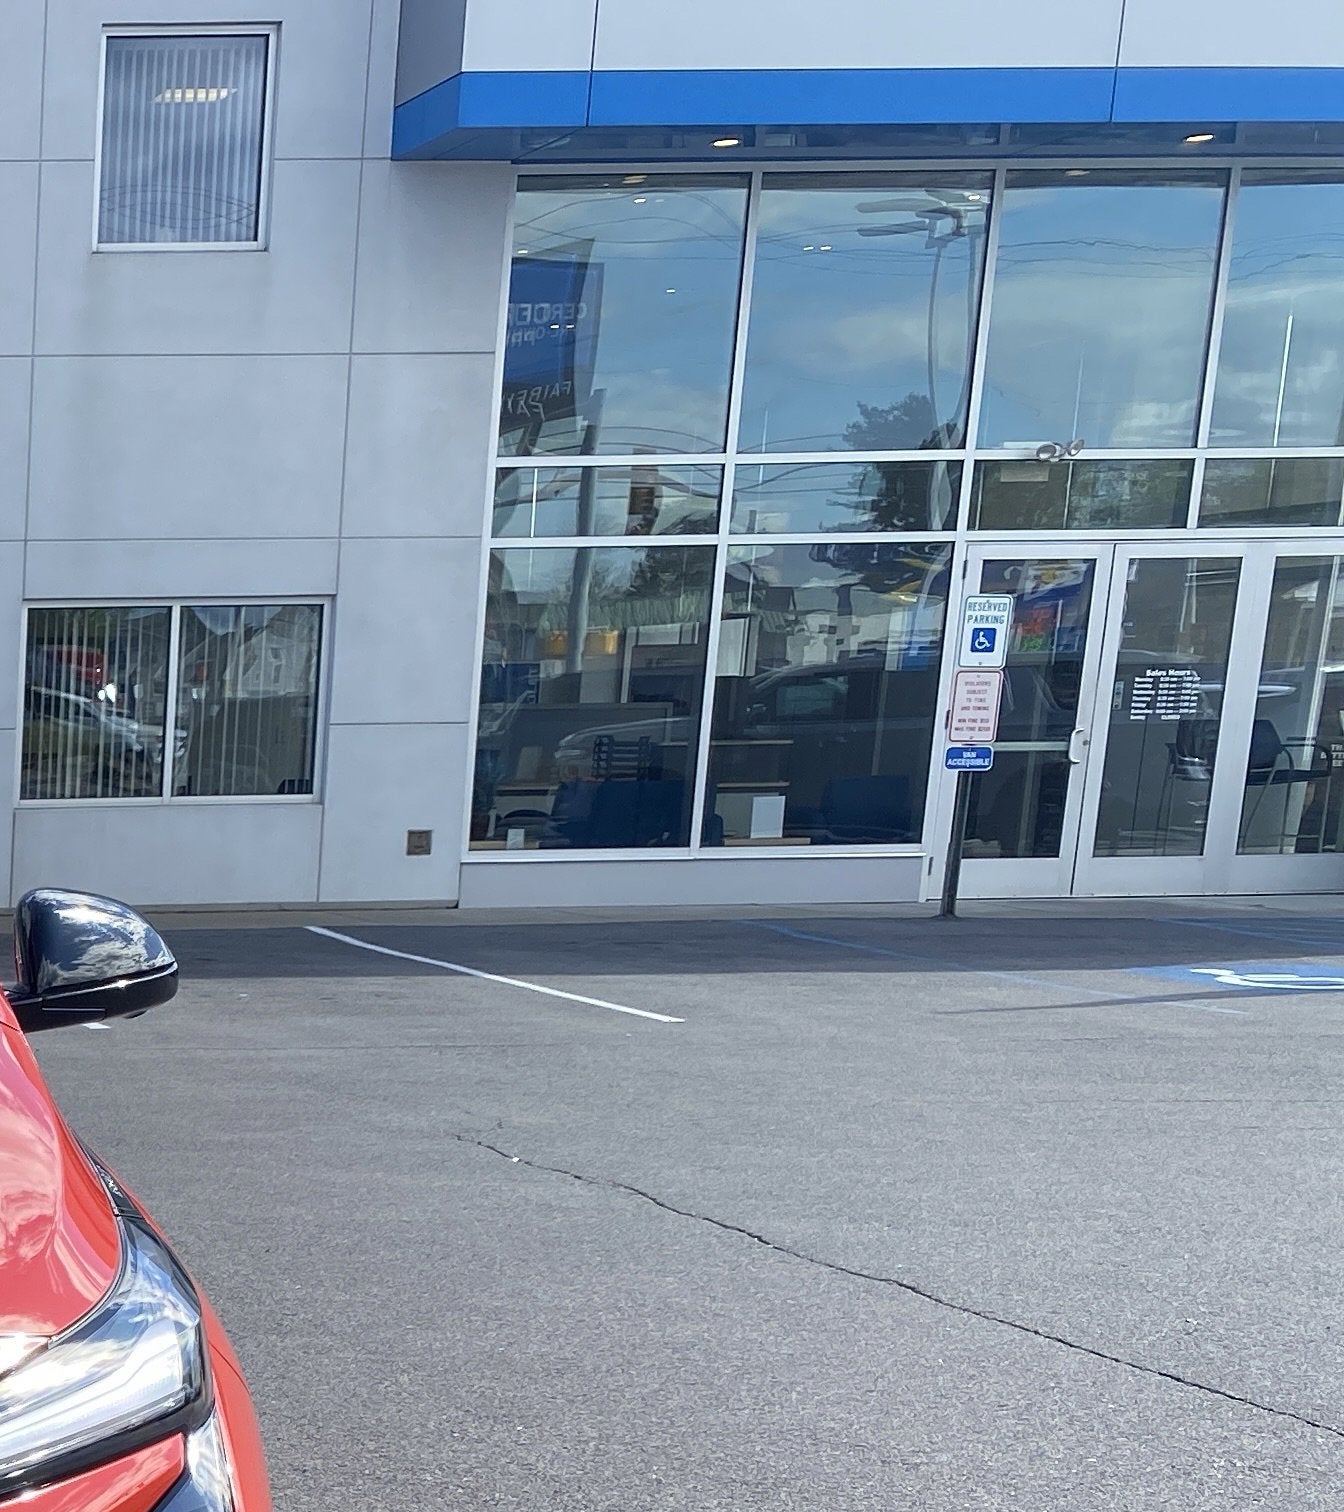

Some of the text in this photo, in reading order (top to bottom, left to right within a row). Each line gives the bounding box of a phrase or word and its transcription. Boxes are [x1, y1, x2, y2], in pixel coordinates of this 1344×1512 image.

[968, 602, 1008, 612] RESERVED
[967, 615, 1006, 624] PARKING
[947, 758, 990, 766] ACCESSIBLE
